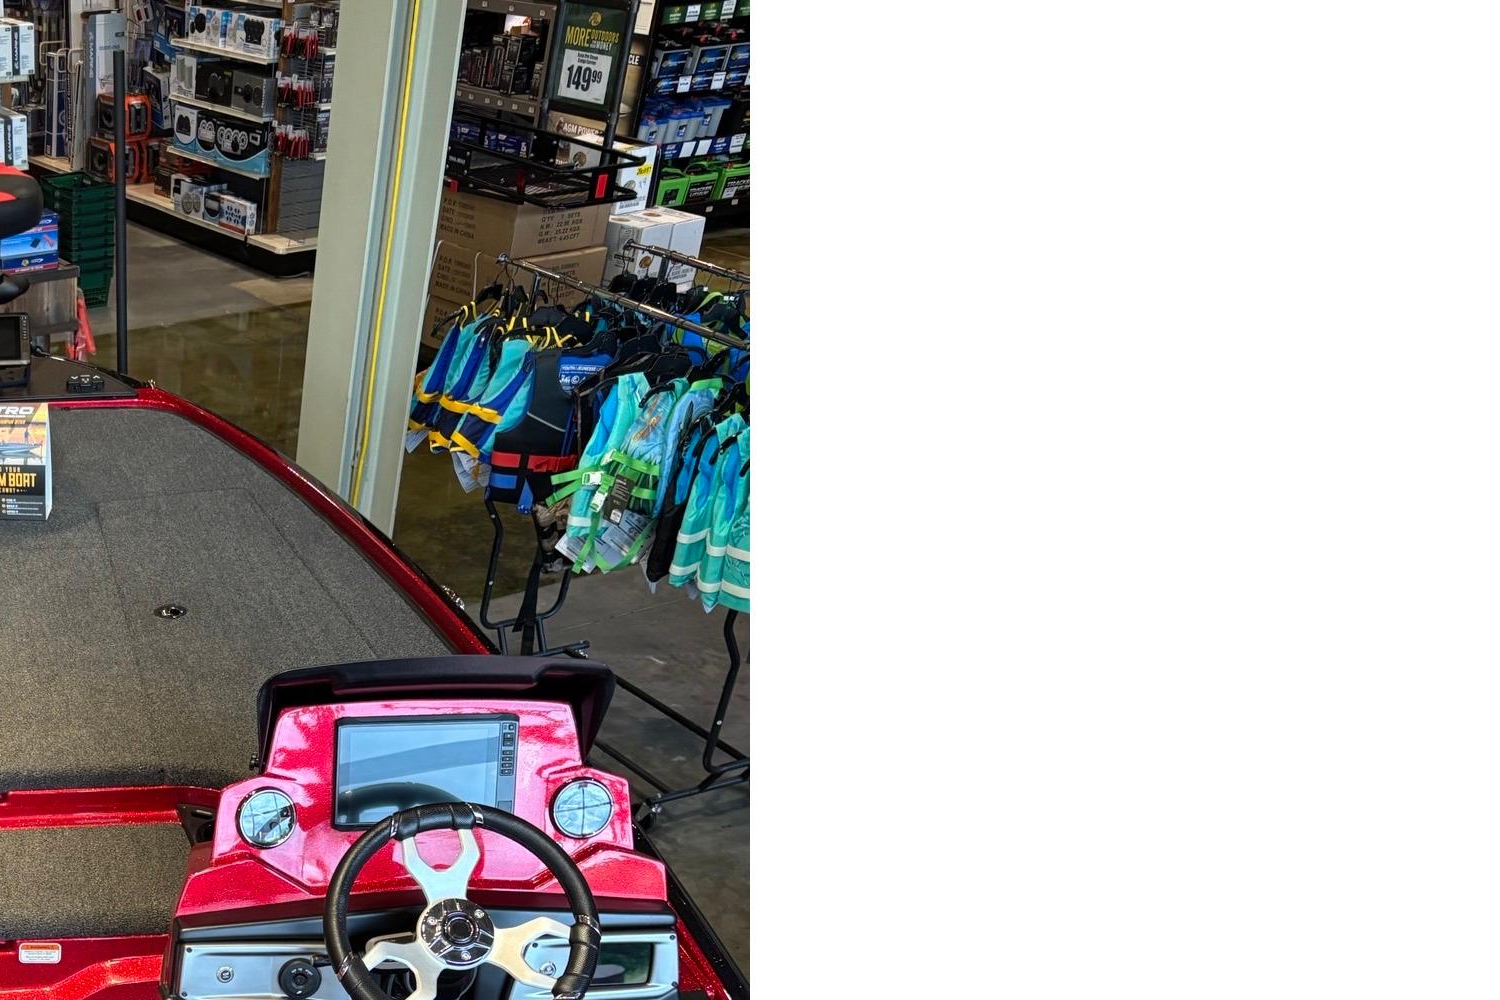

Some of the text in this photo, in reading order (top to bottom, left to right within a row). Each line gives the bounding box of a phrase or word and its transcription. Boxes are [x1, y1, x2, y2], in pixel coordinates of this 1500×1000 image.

[564, 25, 620, 47] MORE OUTDOORS
[8, 473, 36, 488] BOAT
